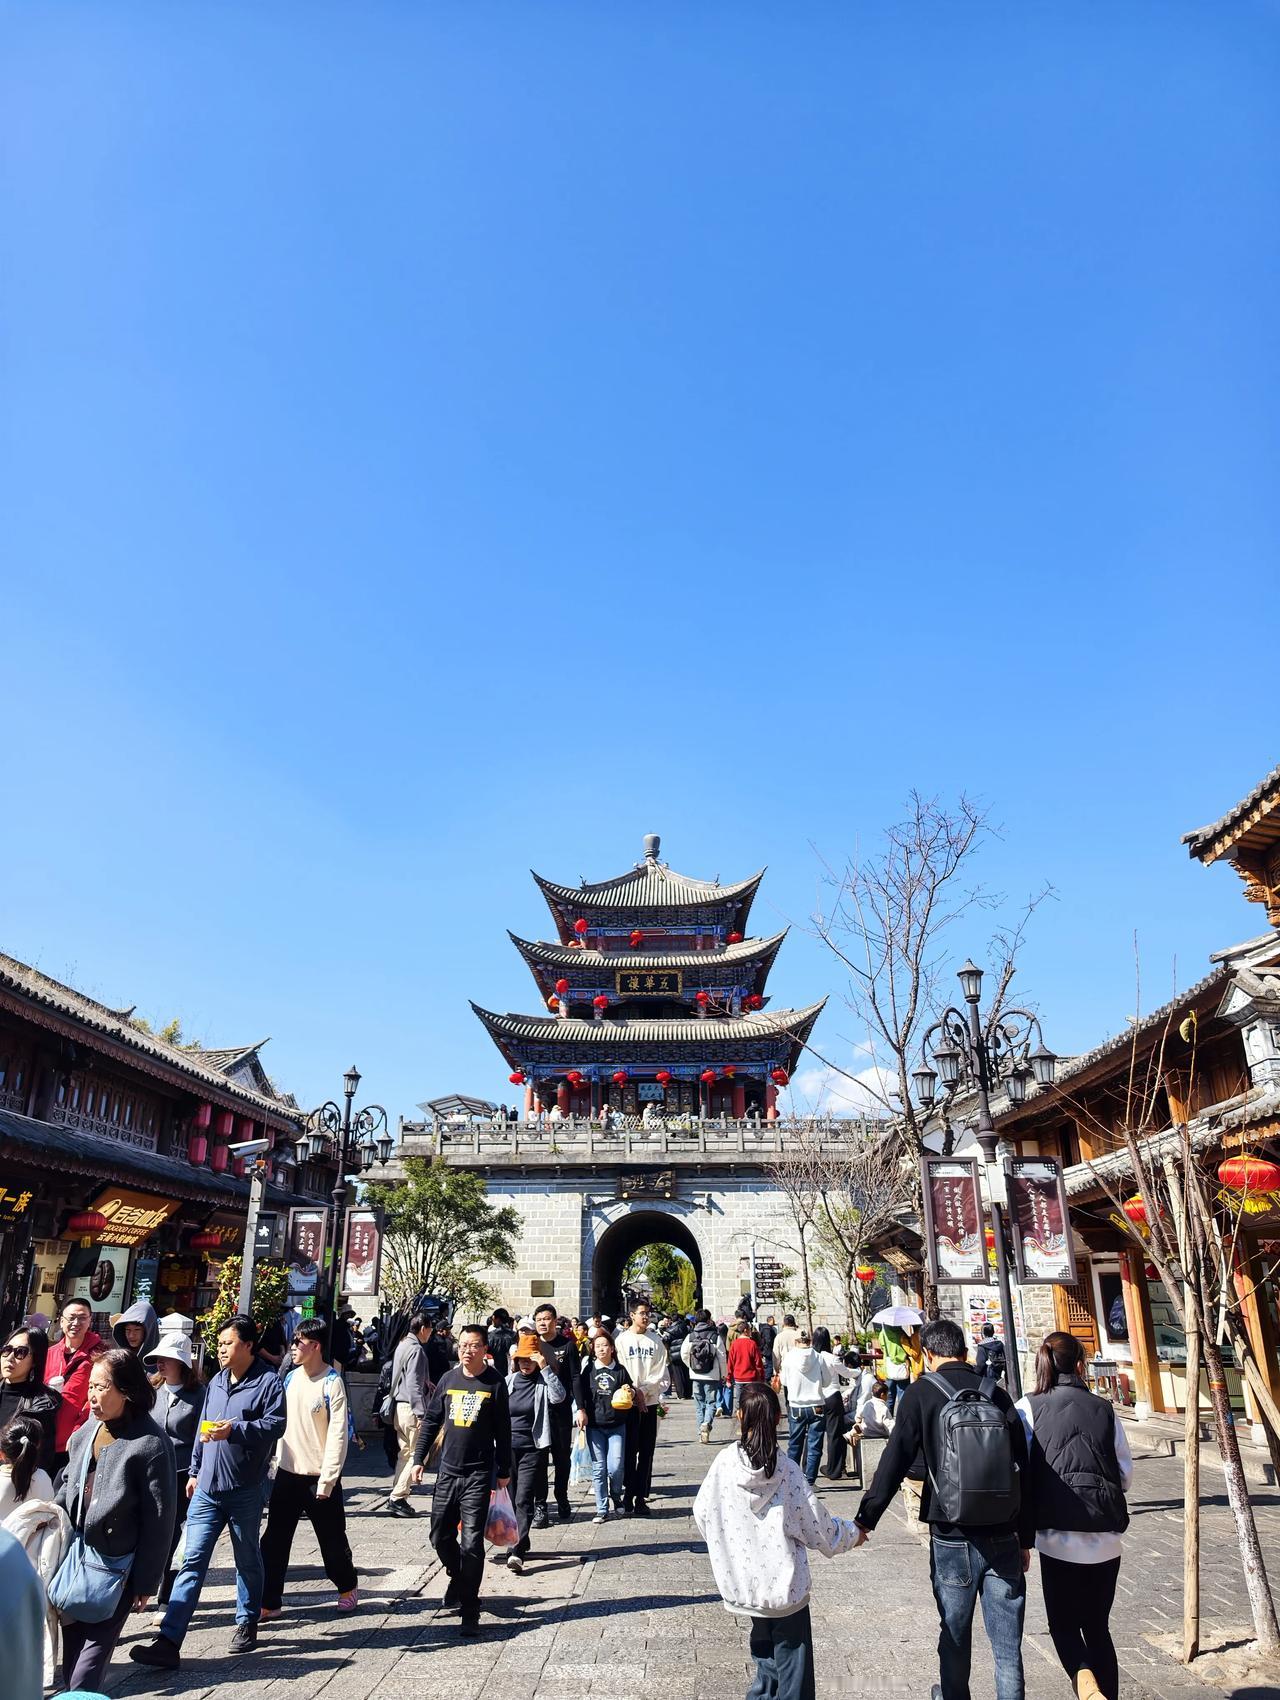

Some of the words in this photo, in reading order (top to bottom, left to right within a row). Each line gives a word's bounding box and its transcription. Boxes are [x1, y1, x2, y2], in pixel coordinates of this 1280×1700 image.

[109, 1203, 169, 1229] 后谷咖啡
[127, 1227, 149, 1236] COFFEE
